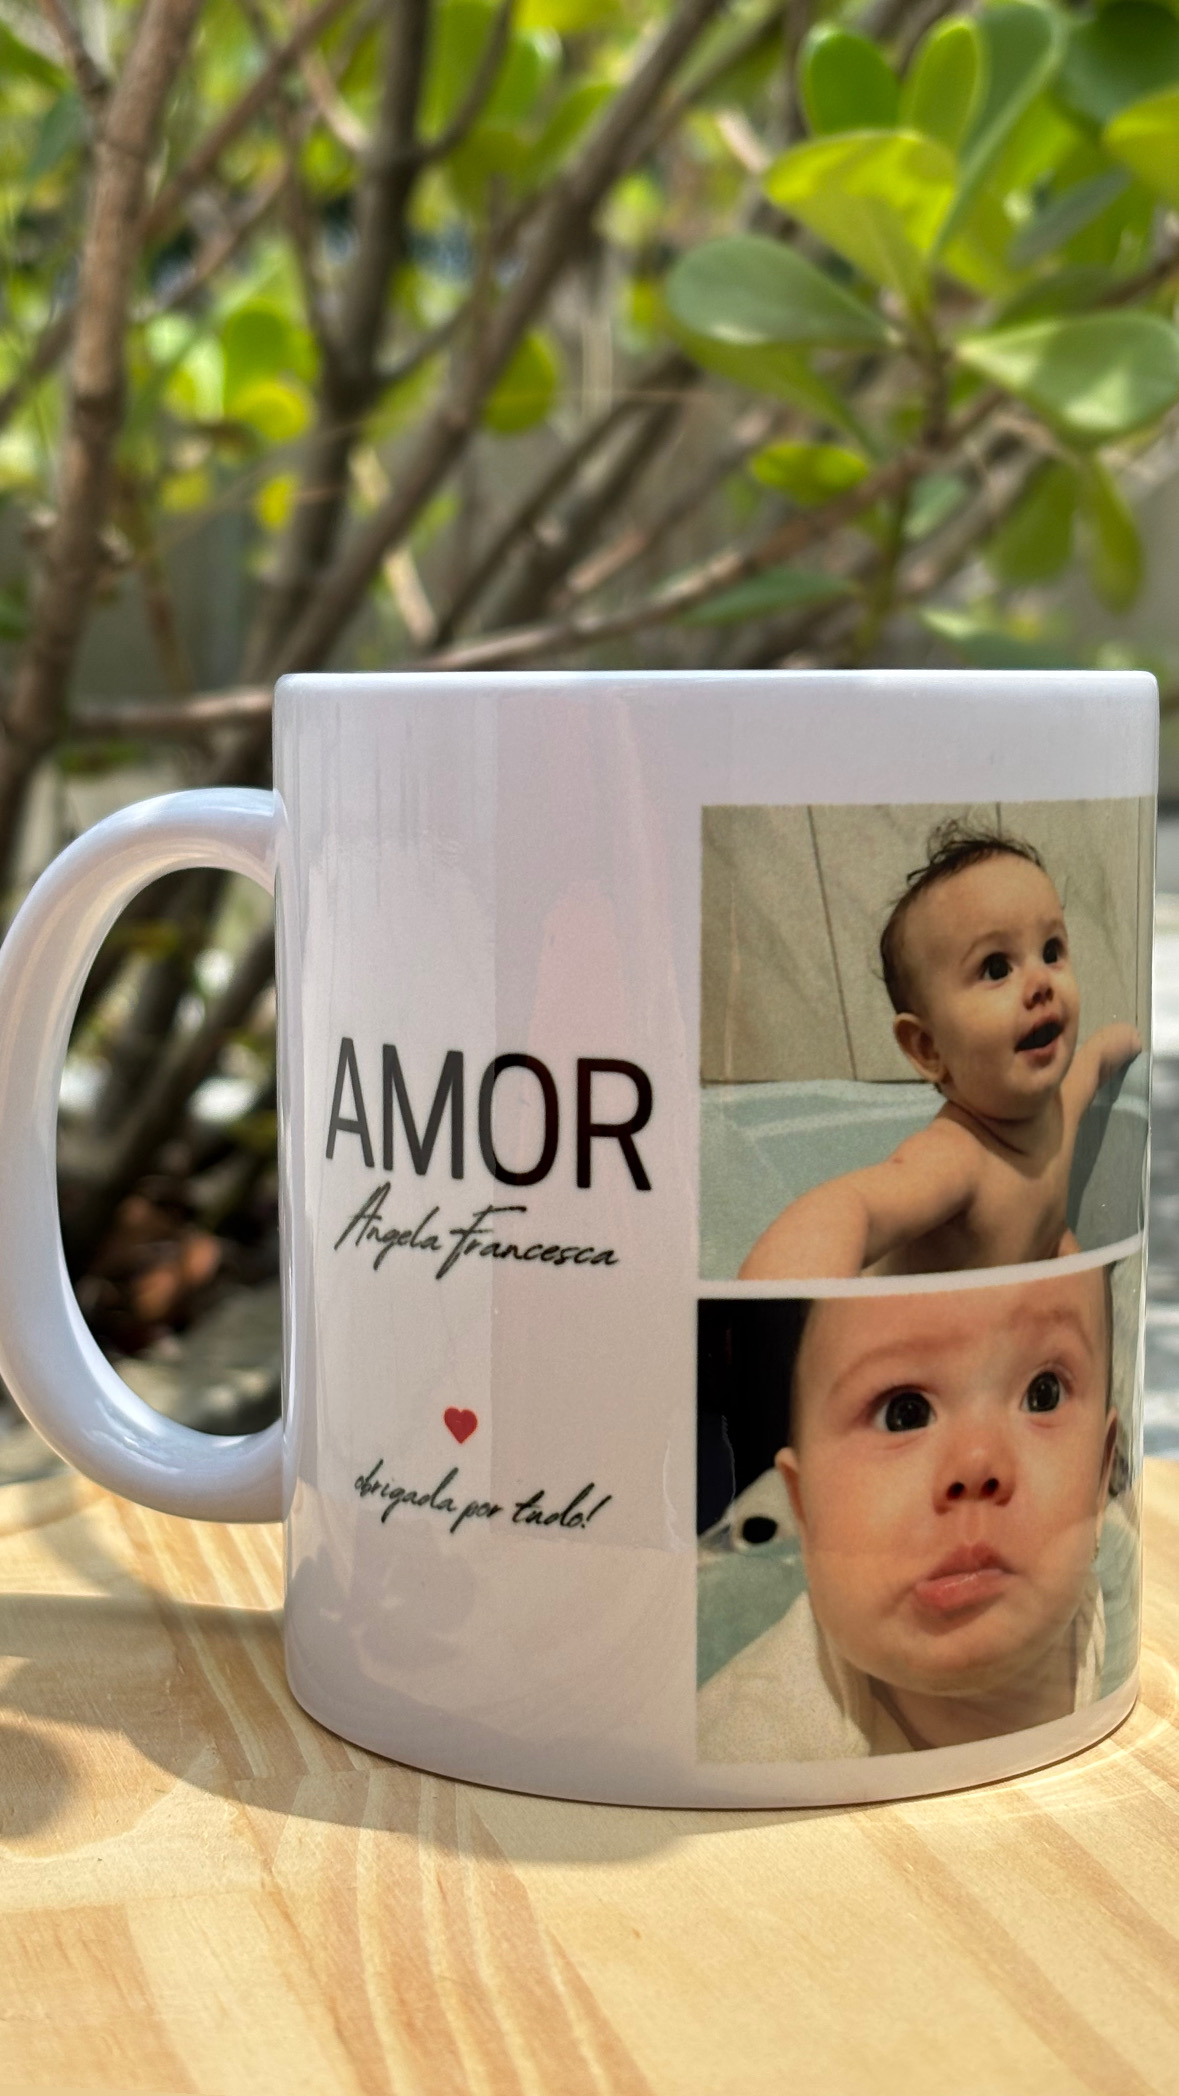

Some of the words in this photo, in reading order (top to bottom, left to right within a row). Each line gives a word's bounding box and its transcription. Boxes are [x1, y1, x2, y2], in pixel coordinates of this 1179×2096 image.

[326, 1037, 653, 1191] AMOR
[334, 1181, 441, 1271] Angela
[435, 1204, 619, 1280] Francesca
[354, 1458, 459, 1524] obrigada
[450, 1502, 503, 1534] por
[511, 1482, 612, 1529] tudo!
